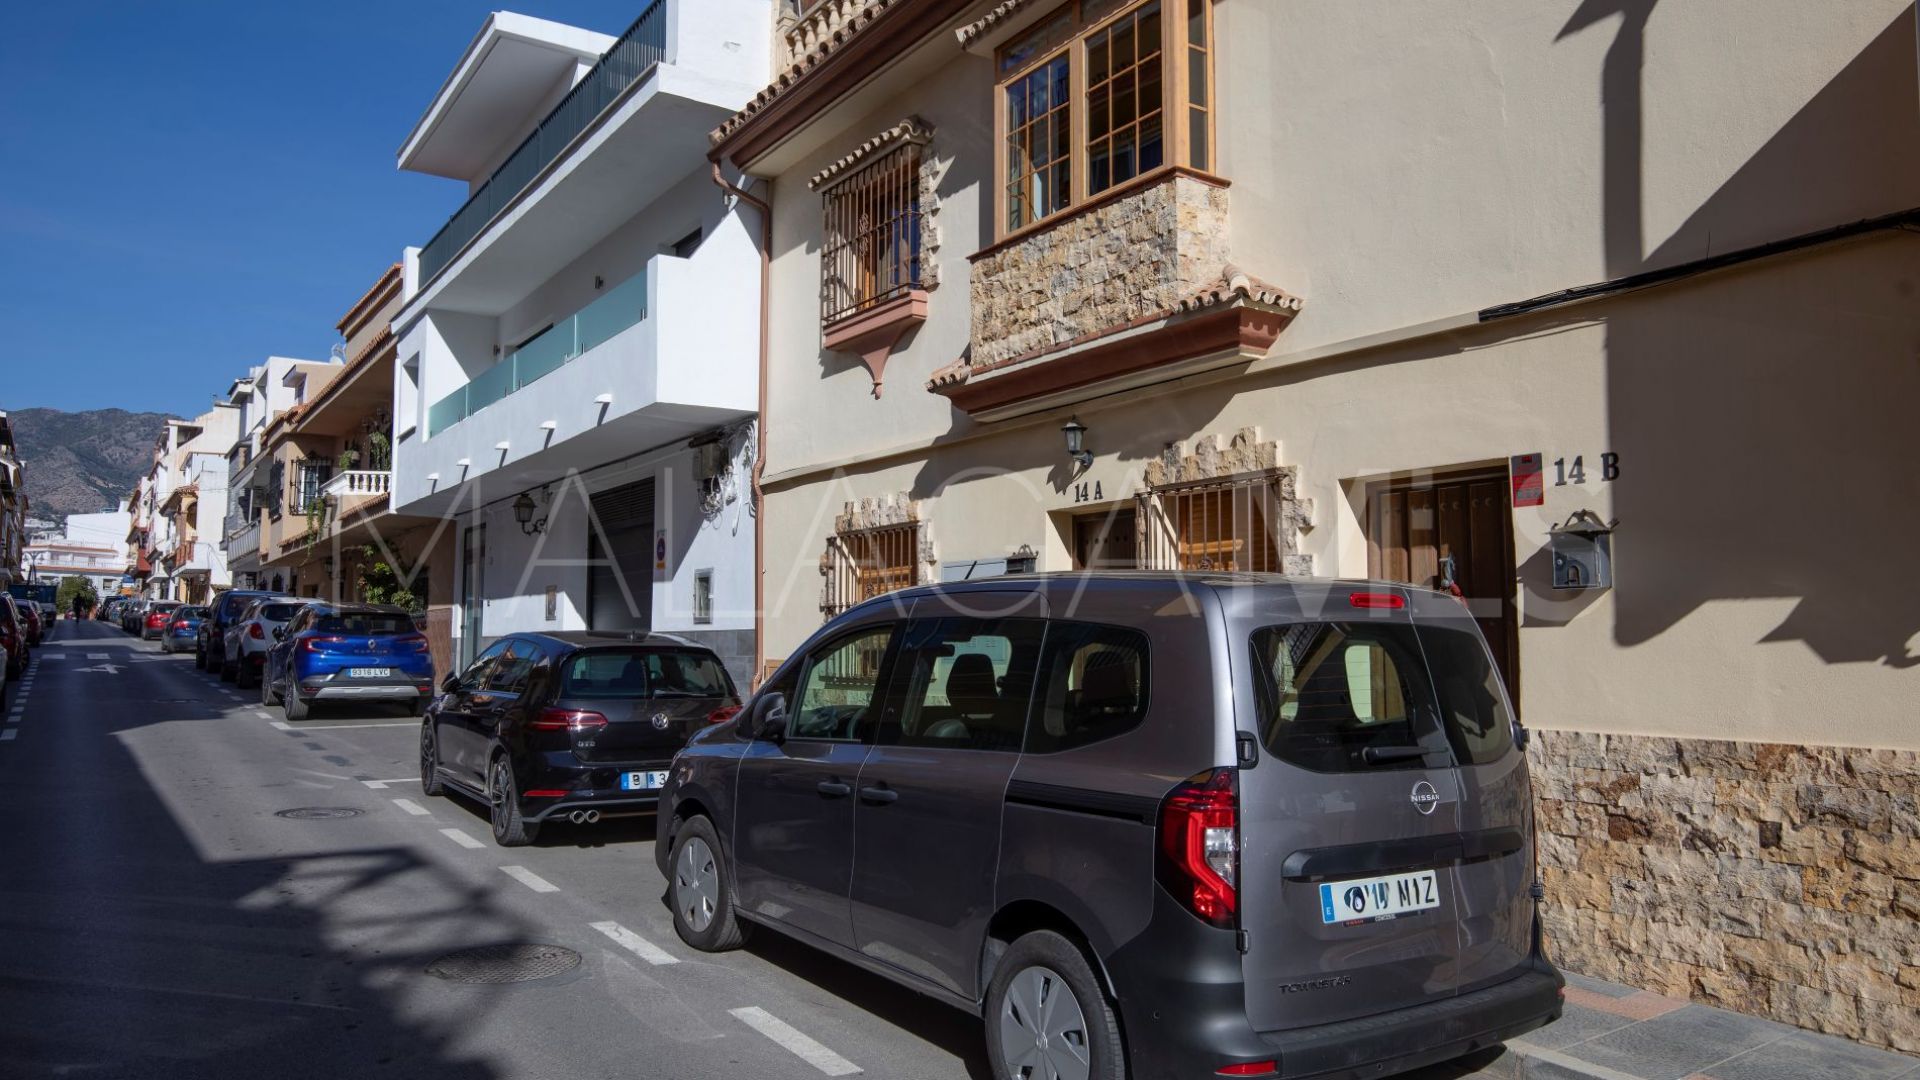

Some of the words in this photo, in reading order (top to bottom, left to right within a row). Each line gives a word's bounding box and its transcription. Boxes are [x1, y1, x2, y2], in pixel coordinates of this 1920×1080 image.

[1554, 455, 1586, 486] 14
[1600, 452, 1620, 482] B
[1075, 481, 1089, 503] 14
[1094, 480, 1103, 500] A
[1410, 794, 1440, 803] NISSAN
[1278, 974, 1352, 995] TOWNSTAR
